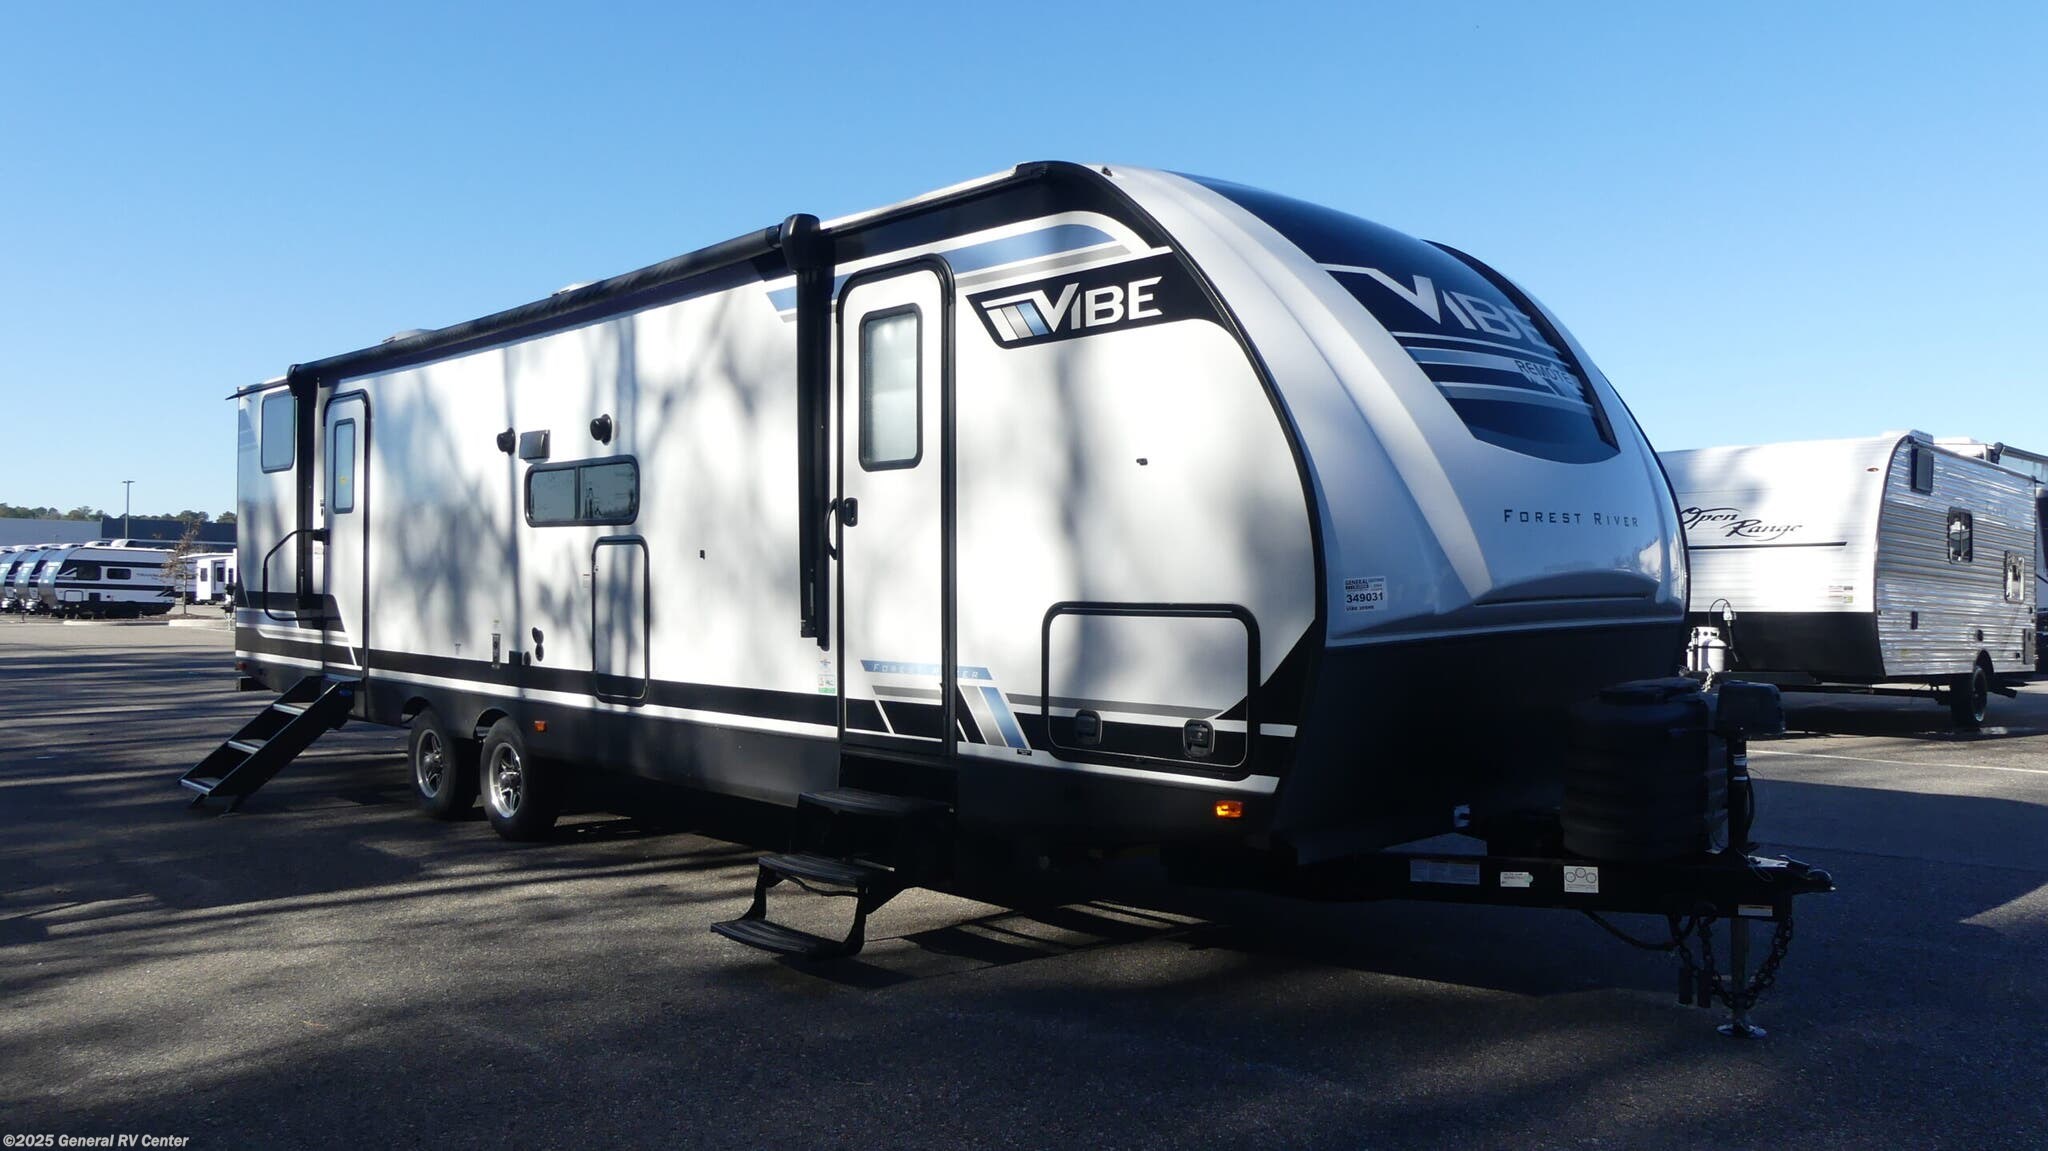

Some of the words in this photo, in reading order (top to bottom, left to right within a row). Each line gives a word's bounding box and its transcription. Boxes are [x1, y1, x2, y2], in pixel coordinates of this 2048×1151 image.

[981, 276, 1163, 333] VIBE
[1322, 265, 1561, 353] VIBE
[1514, 359, 1574, 385] REMOTE
[1503, 508, 1581, 524] FOREST
[1593, 512, 1639, 528] RIVER
[1681, 506, 1742, 530] Open
[1720, 519, 1803, 541] Range
[1346, 591, 1384, 603] 349031
